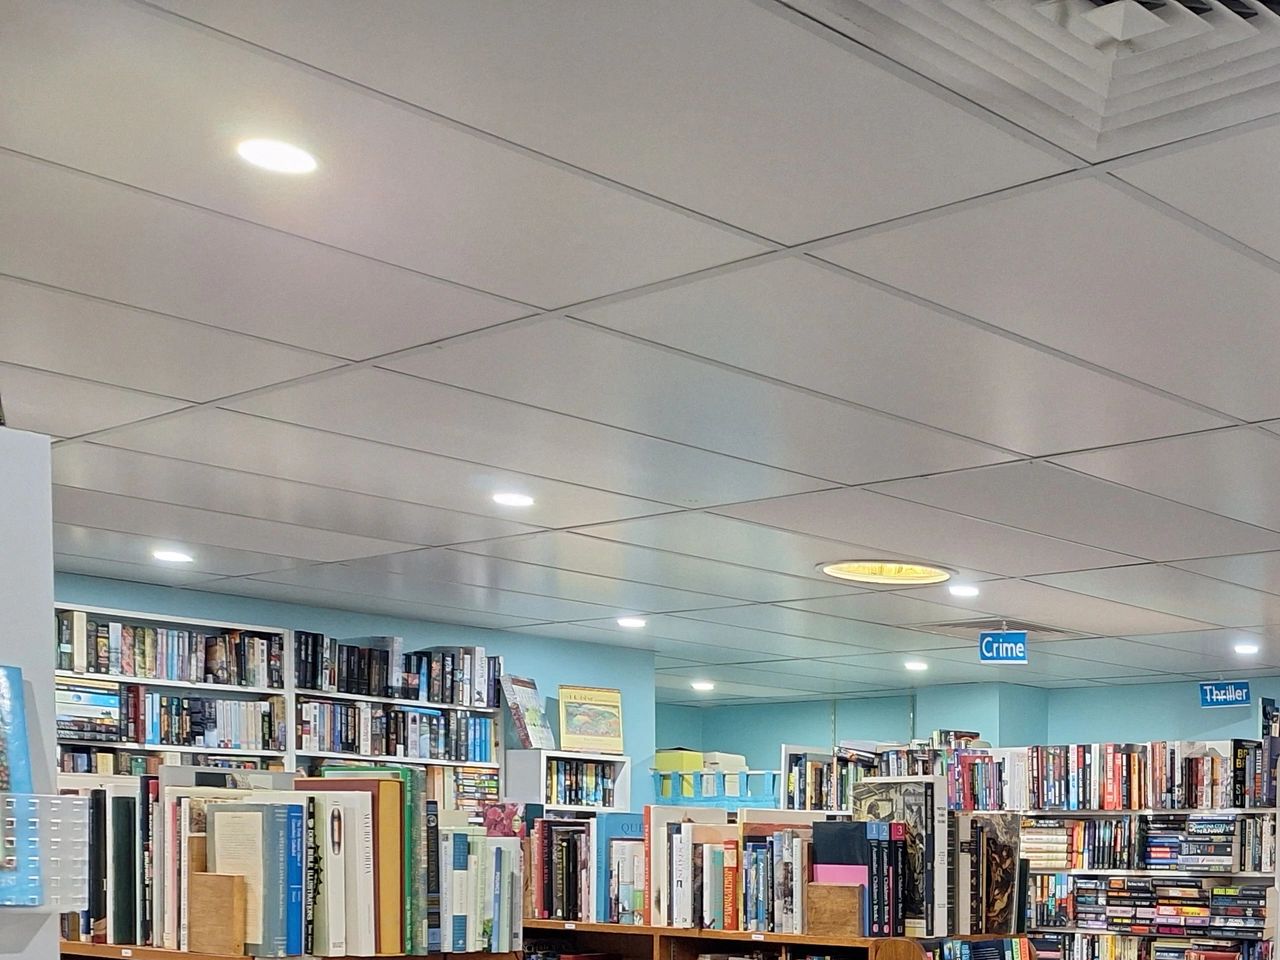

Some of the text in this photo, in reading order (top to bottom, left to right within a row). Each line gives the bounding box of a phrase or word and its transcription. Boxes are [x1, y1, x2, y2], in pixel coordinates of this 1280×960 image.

[982, 638, 1025, 658] Crime
[1204, 684, 1248, 704] Thriller
[363, 813, 371, 842] MAURO
[871, 824, 876, 834] 1
[882, 825, 888, 835] 2
[896, 825, 903, 835] 3
[306, 870, 314, 920] ILLUSTRATIONS
